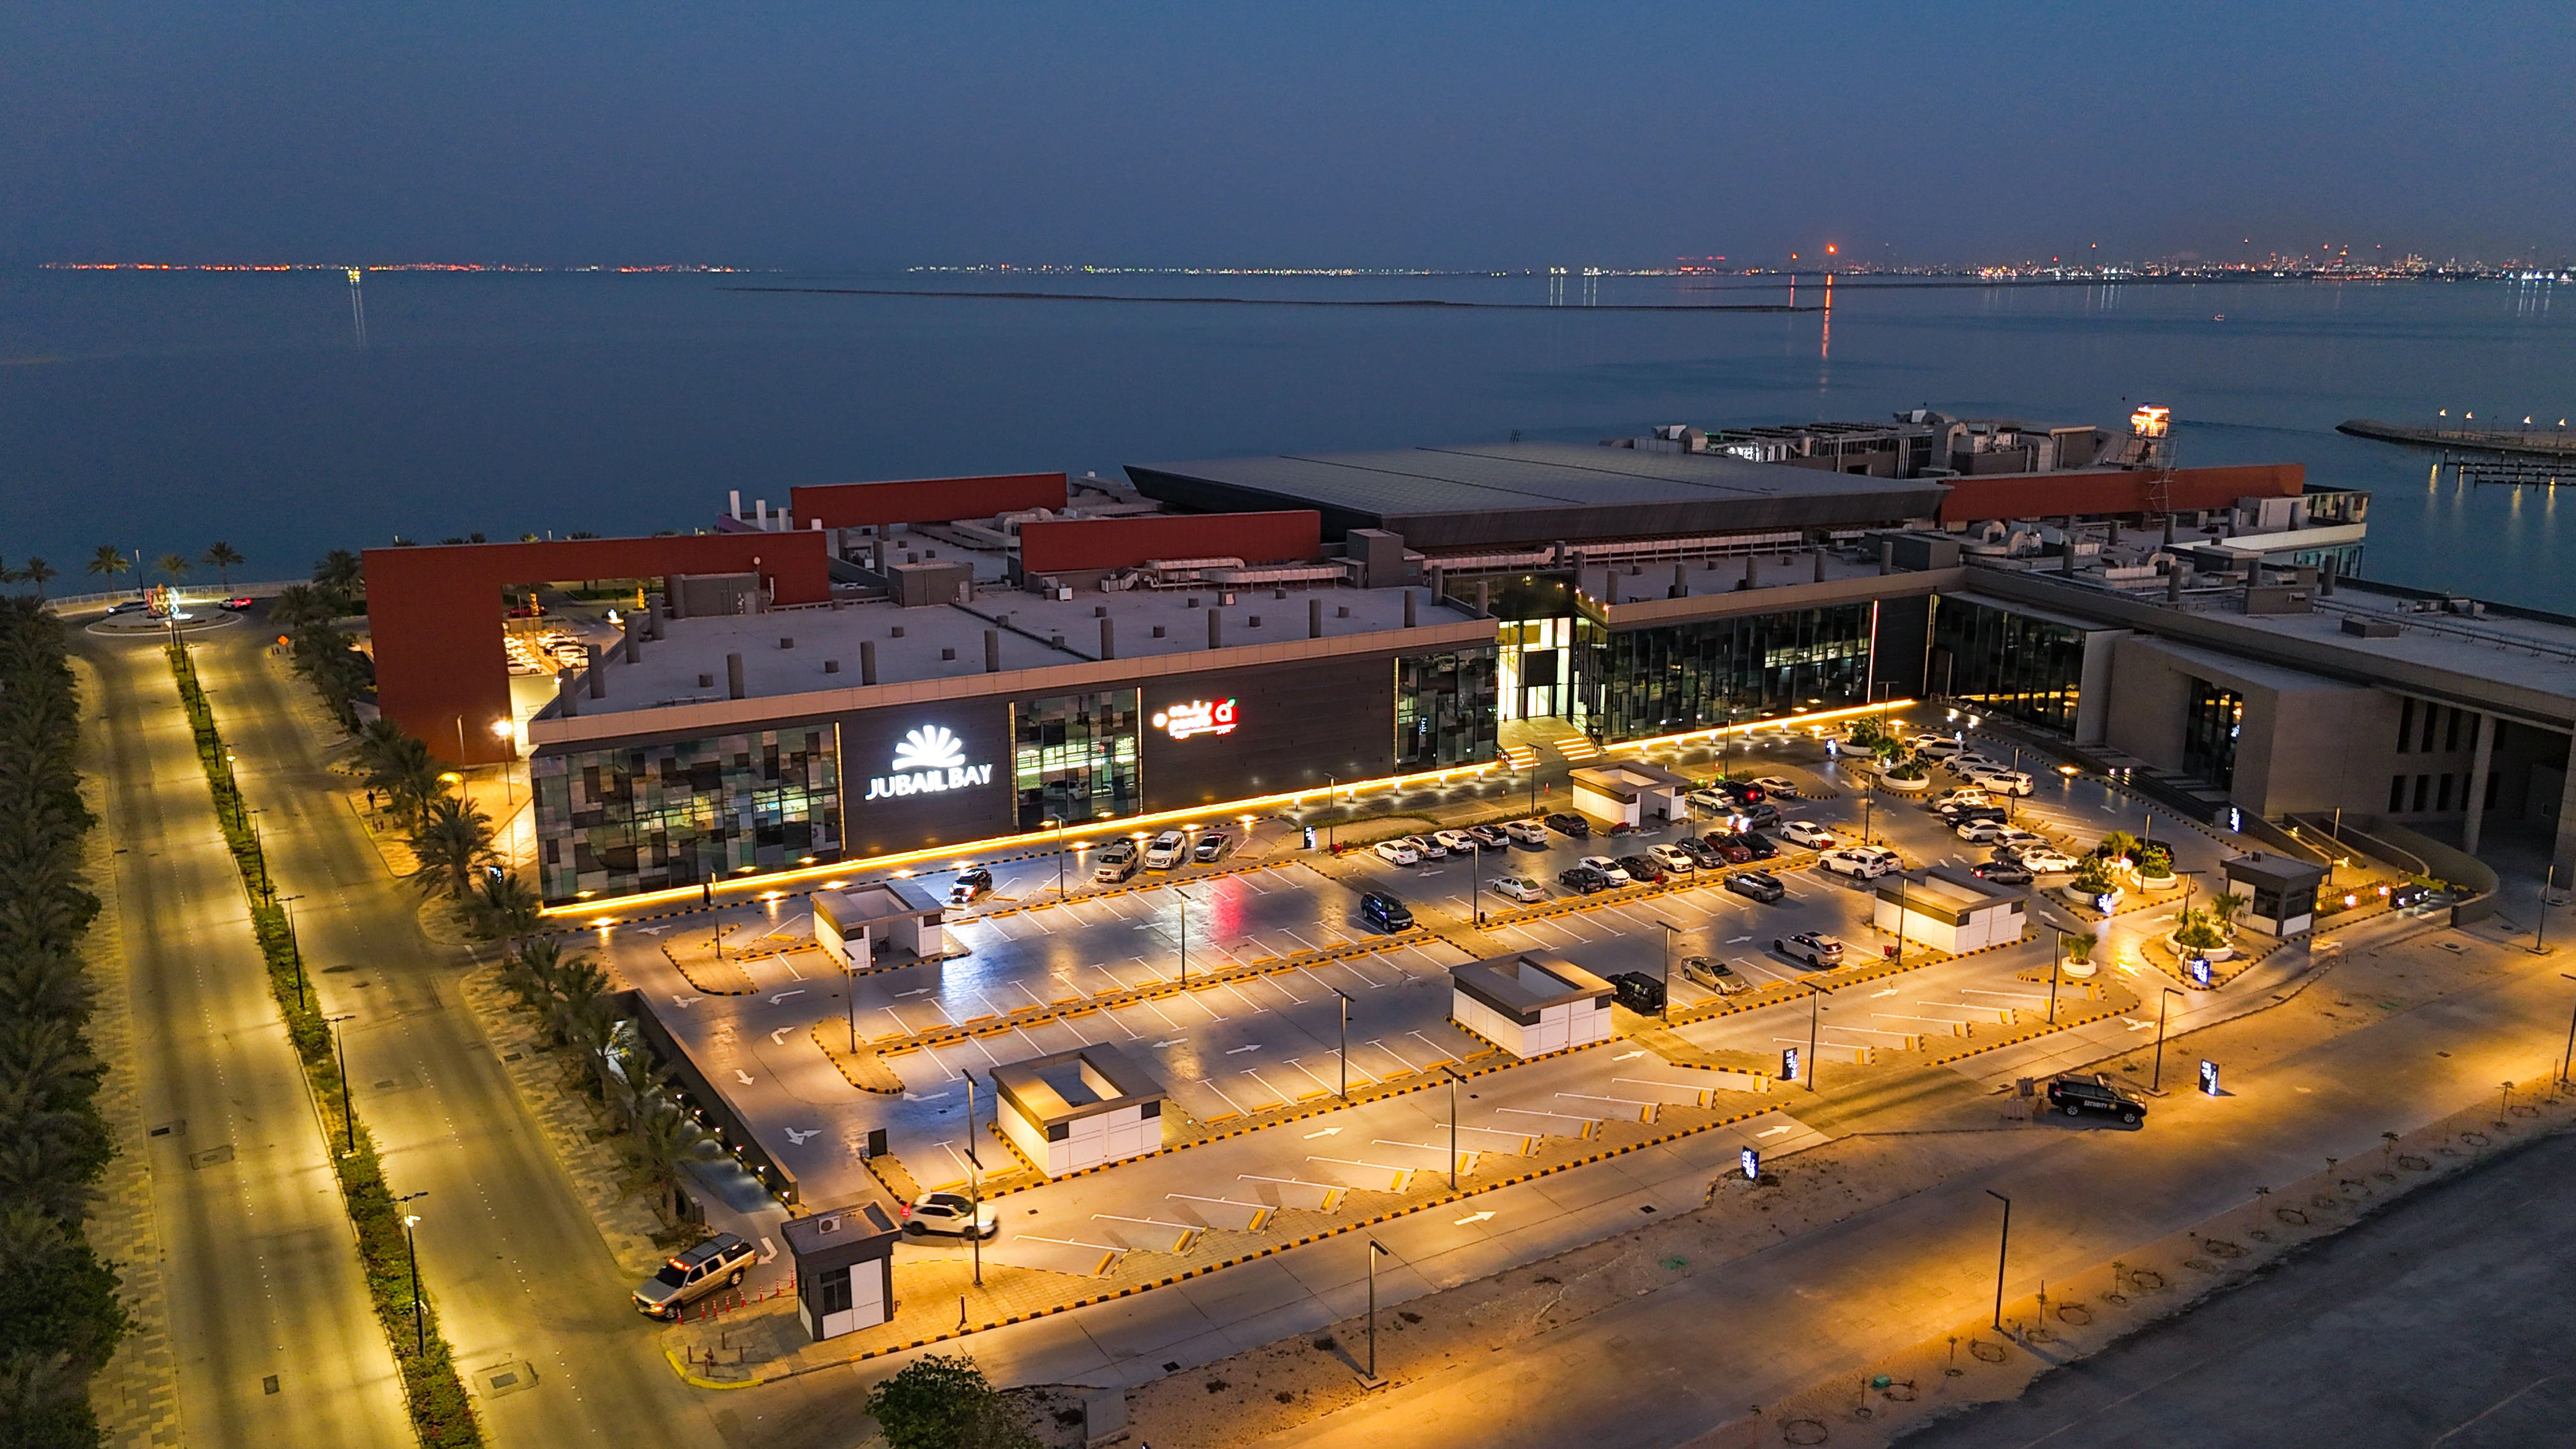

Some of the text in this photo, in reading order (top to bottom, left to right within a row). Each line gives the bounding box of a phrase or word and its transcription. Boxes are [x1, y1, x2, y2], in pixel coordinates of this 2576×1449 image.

[864, 763, 993, 801] JUBAIL BAY
[2083, 1100, 2108, 1109] SECURITY
